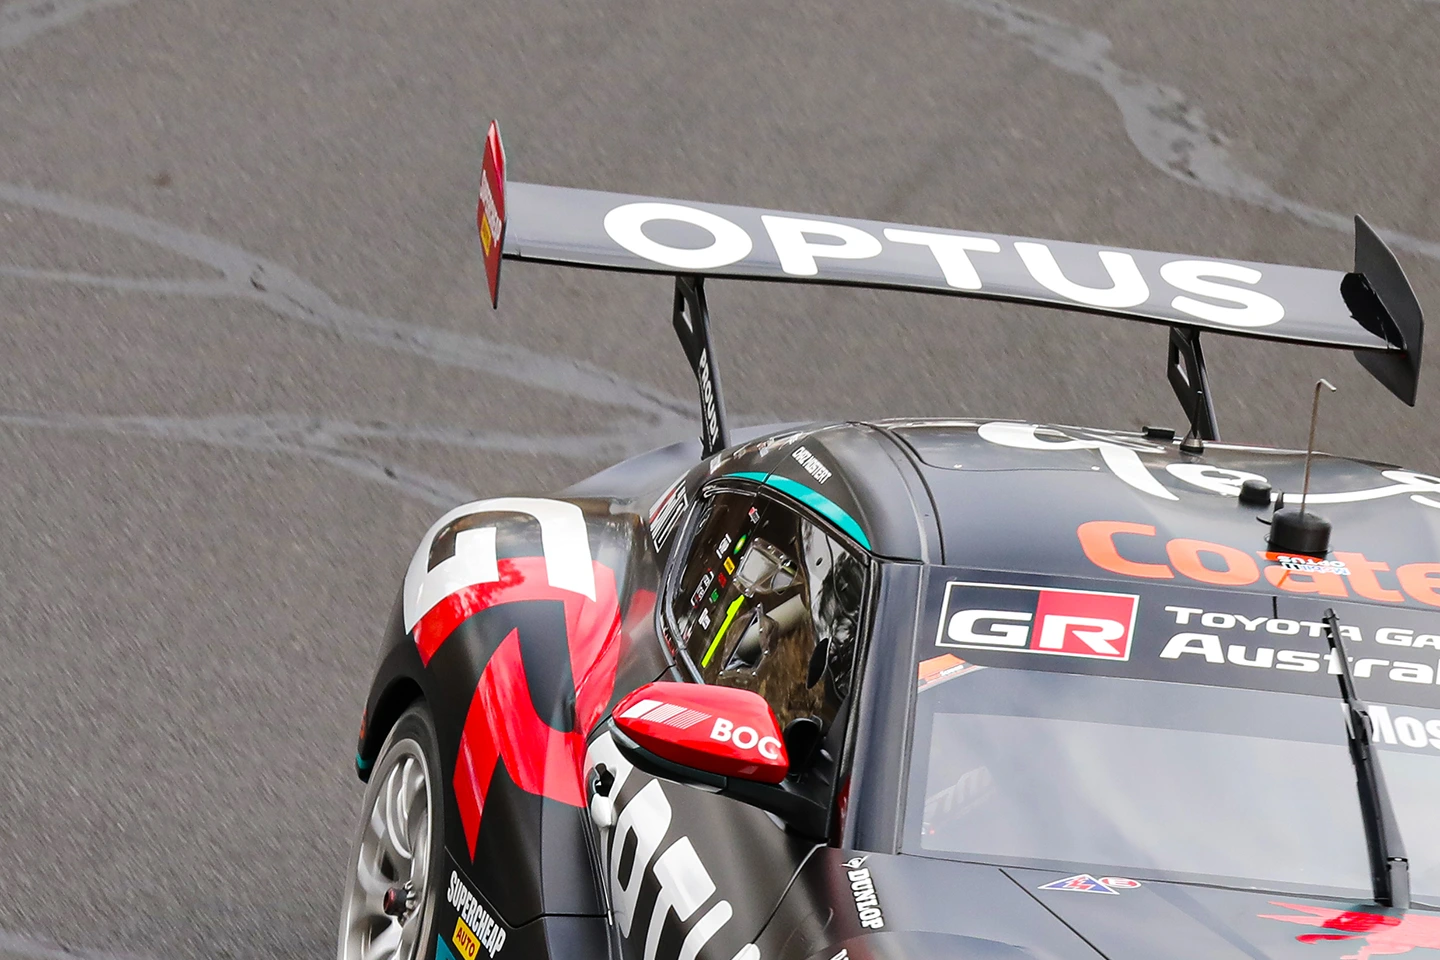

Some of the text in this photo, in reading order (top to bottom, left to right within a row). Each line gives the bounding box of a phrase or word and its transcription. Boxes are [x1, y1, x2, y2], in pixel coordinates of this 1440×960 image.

[604, 202, 1285, 328] OPTUS
[948, 609, 1124, 655] GR
[1165, 605, 1362, 642] TOYOTA
[710, 718, 782, 760] BOC
[446, 870, 507, 959] SUPERCHEAP
[848, 867, 885, 931] DUNLOP
[456, 928, 475, 957] AUTO
